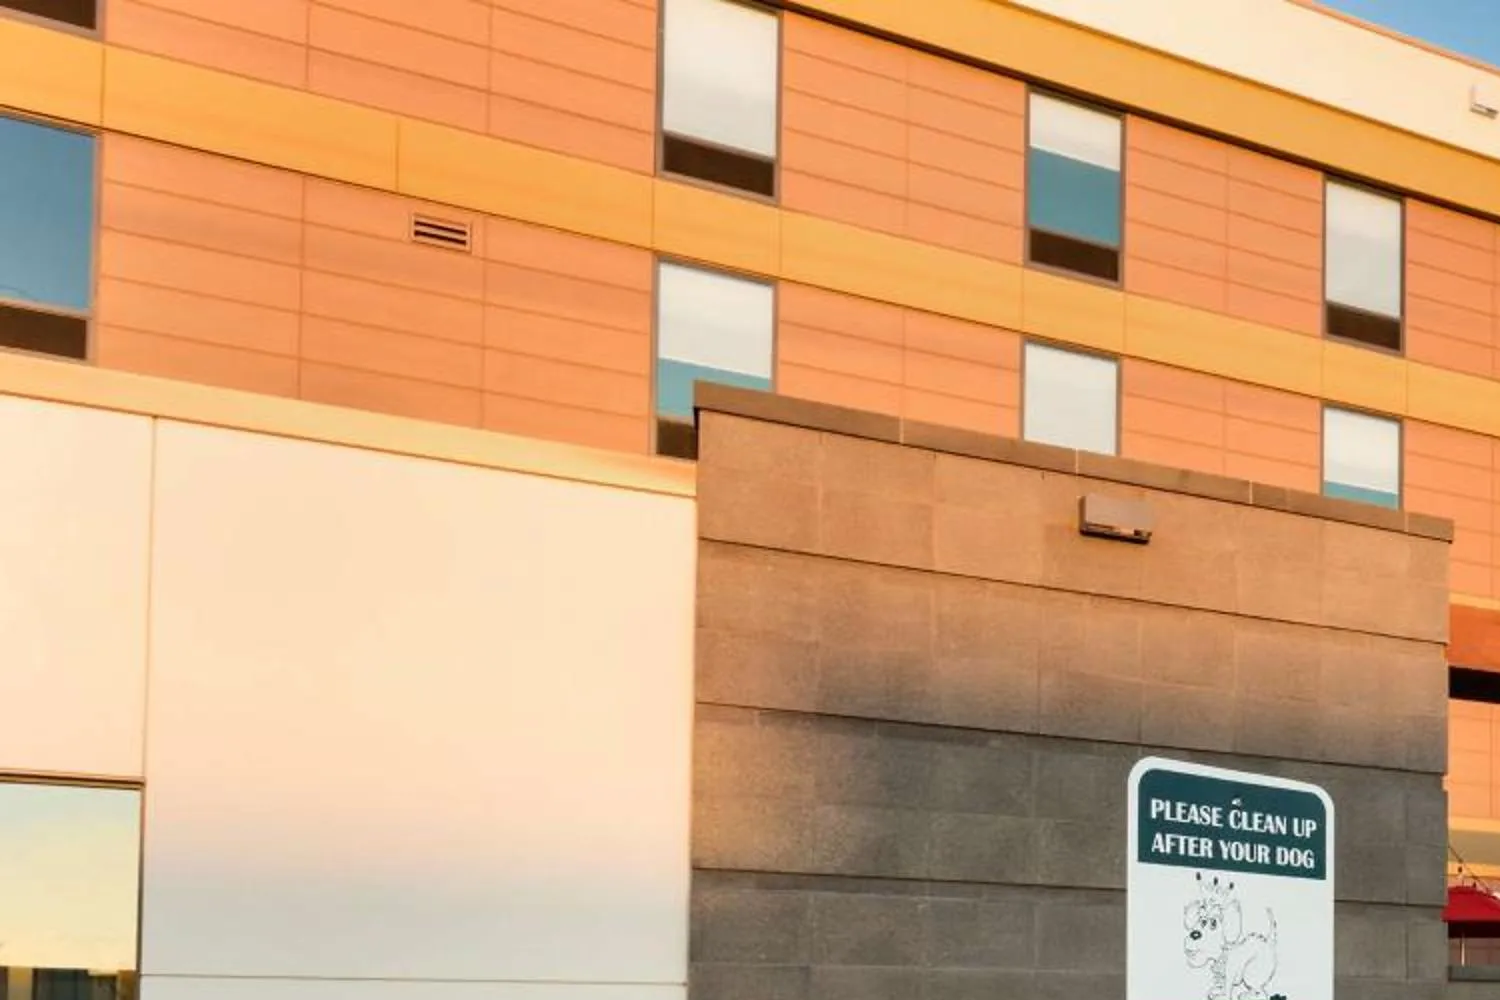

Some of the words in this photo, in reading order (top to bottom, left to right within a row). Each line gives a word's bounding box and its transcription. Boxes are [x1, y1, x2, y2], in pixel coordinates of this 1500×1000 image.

[1151, 798, 1223, 827] PLEASE
[1229, 809, 1287, 835] CLEAN
[1293, 819, 1317, 839] UP
[1151, 833, 1213, 858] AFTER
[1219, 840, 1271, 865] YOUR
[1276, 847, 1315, 869] DOG
